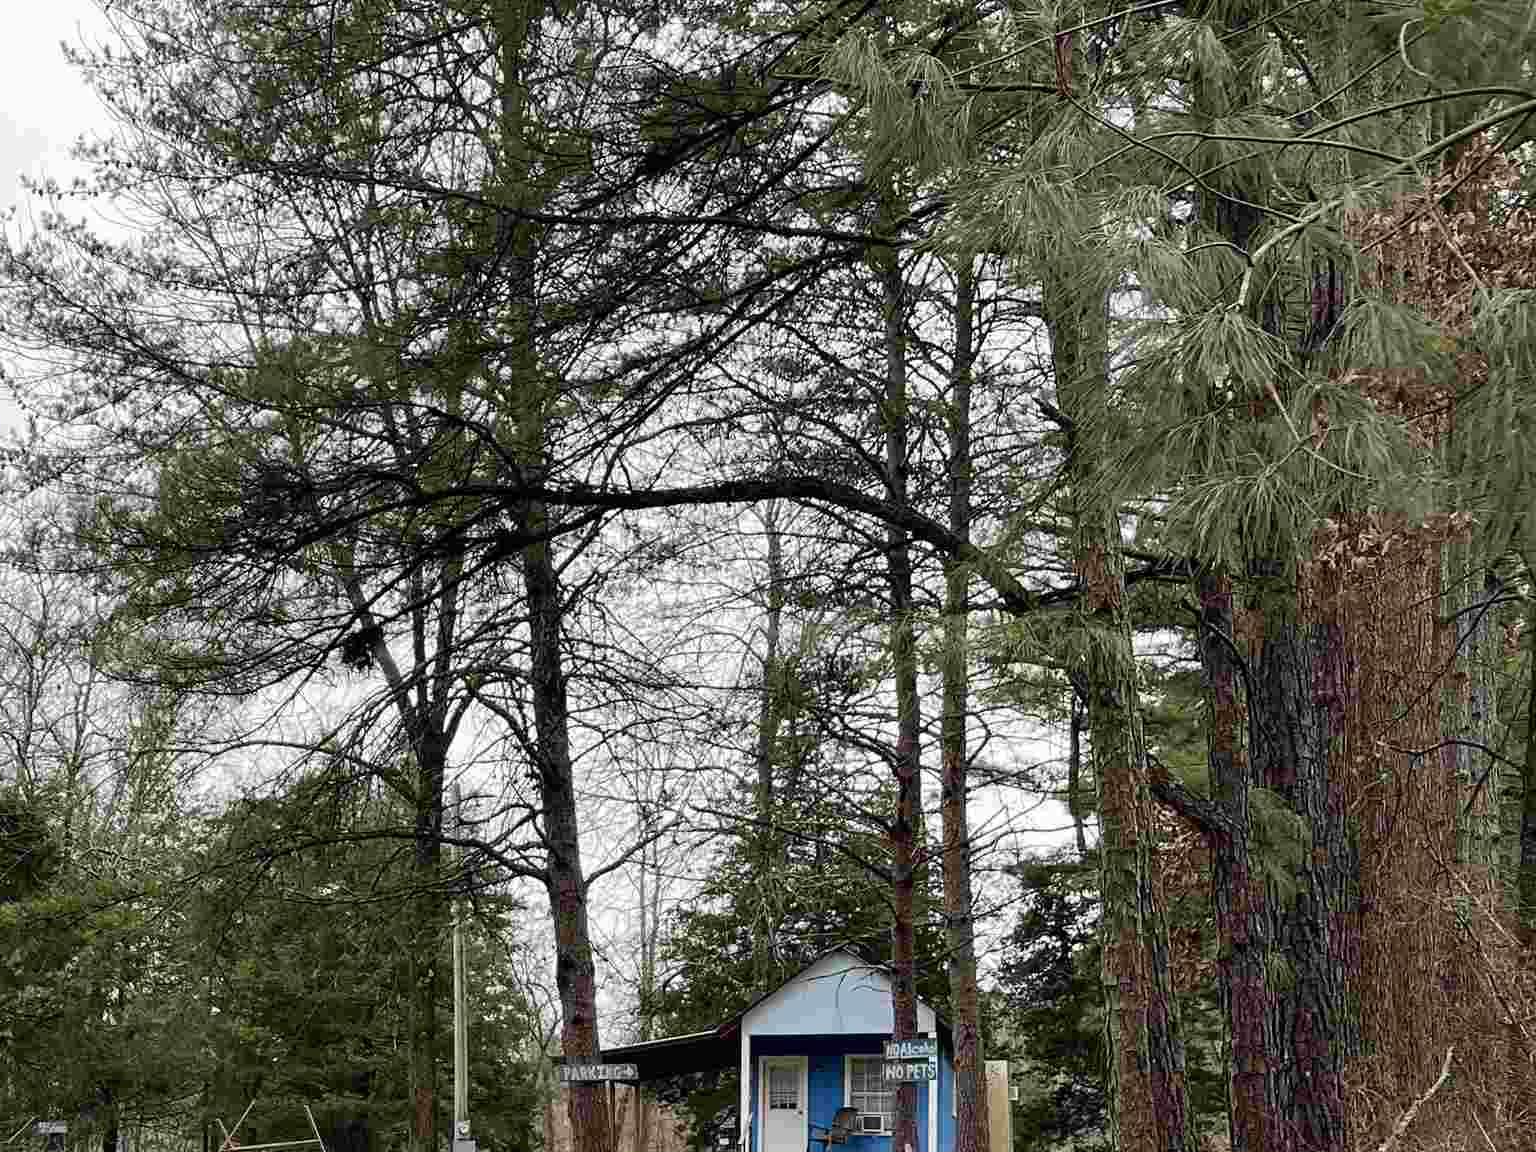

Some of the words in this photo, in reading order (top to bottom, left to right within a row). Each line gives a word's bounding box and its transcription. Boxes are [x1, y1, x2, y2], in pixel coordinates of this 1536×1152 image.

[562, 1064, 622, 1080] PARKING
[885, 1063, 904, 1080] NO
[906, 1063, 936, 1080] PETS
